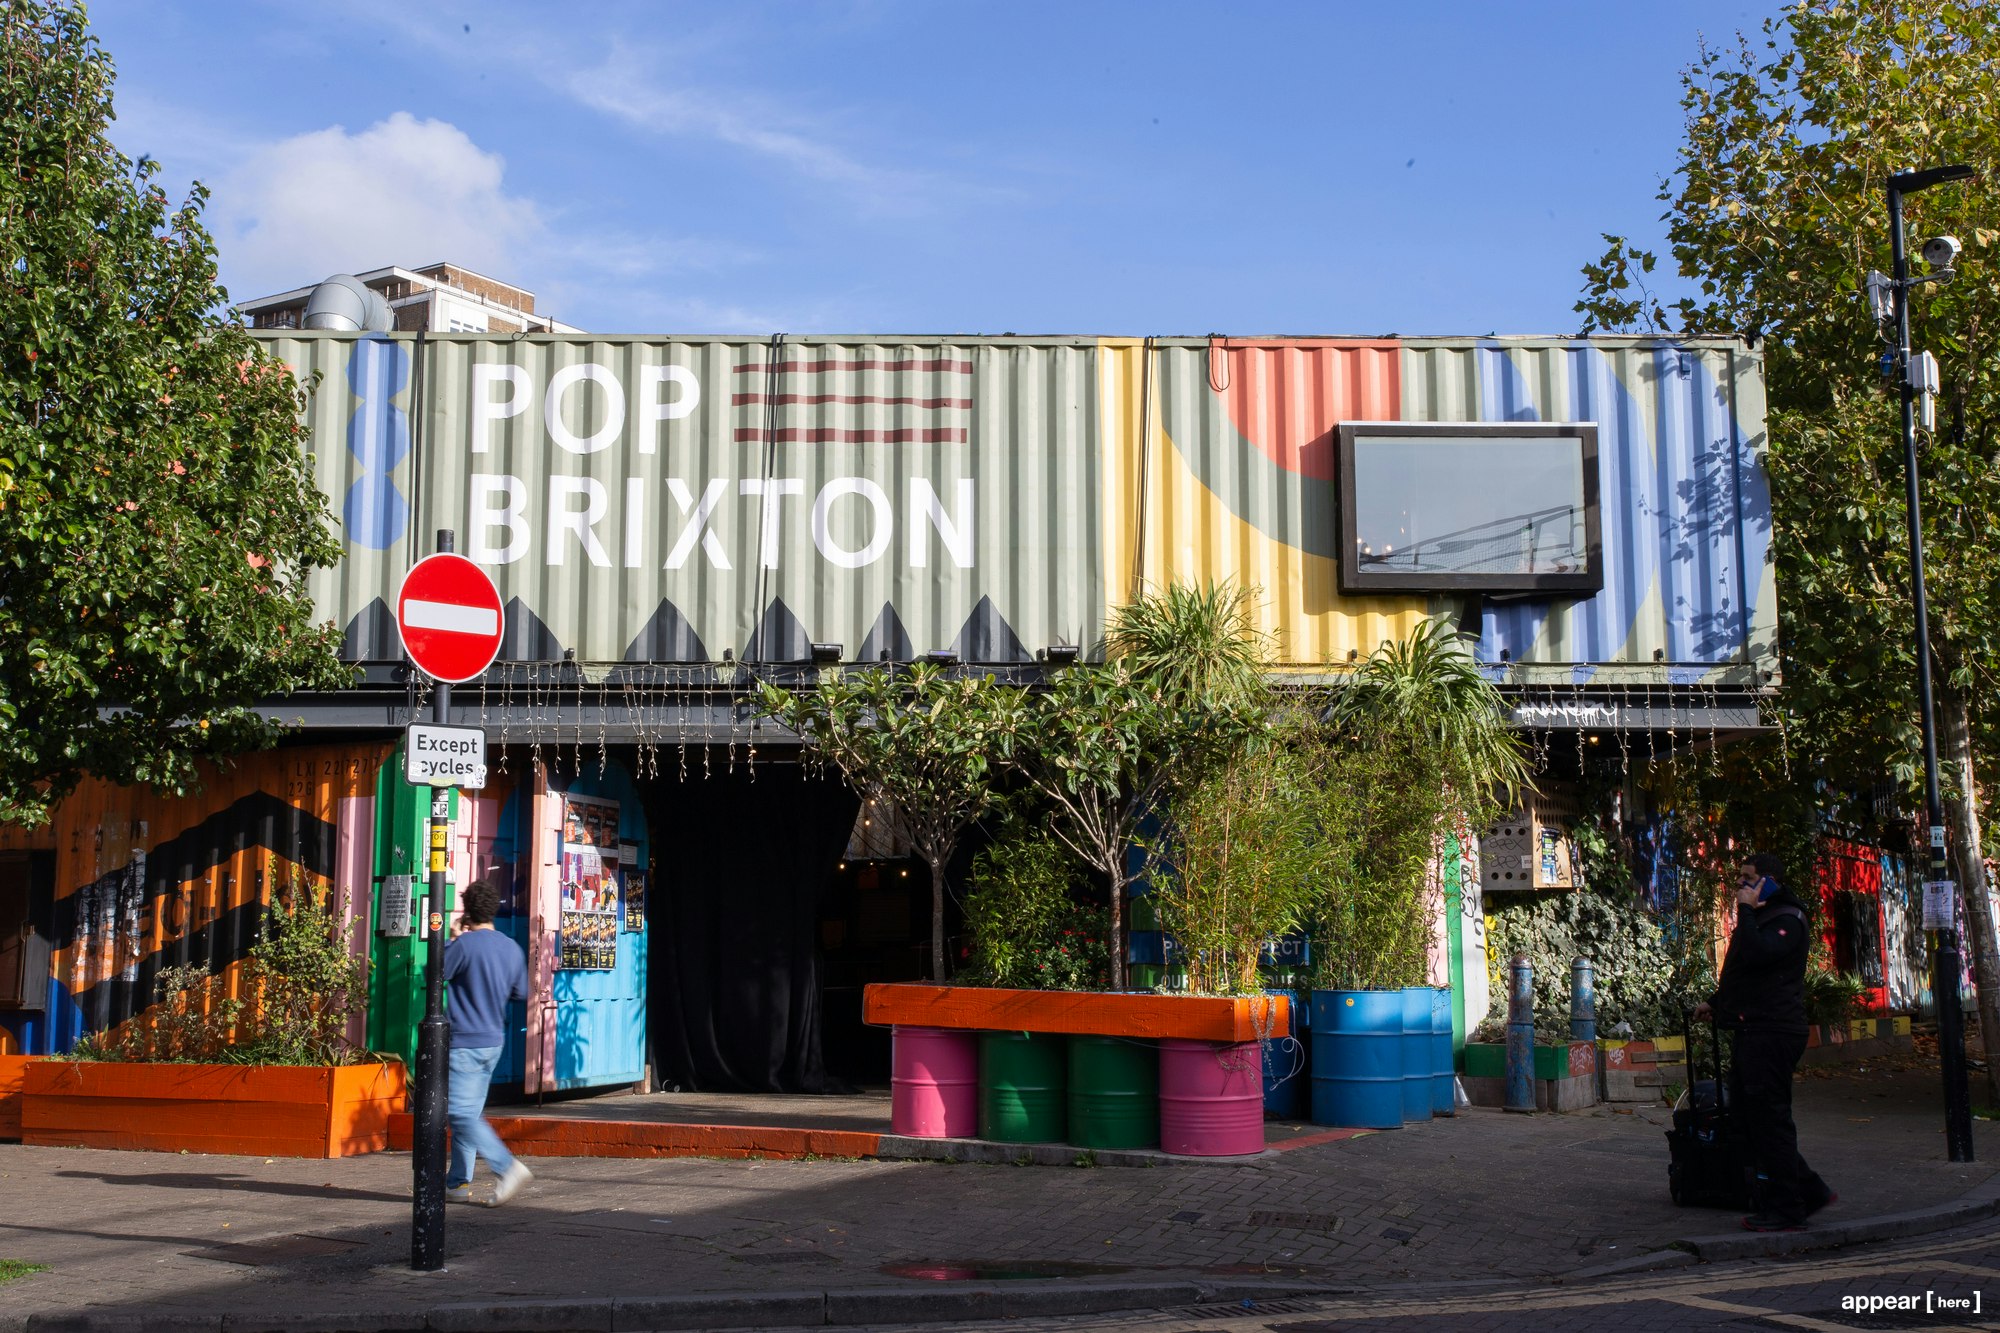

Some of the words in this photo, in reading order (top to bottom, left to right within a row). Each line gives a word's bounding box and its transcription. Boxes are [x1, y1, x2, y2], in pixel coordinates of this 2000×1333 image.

[472, 362, 700, 455] POP
[468, 473, 975, 570] BRIXTON
[417, 733, 478, 756] Except
[420, 758, 474, 777] cycles
